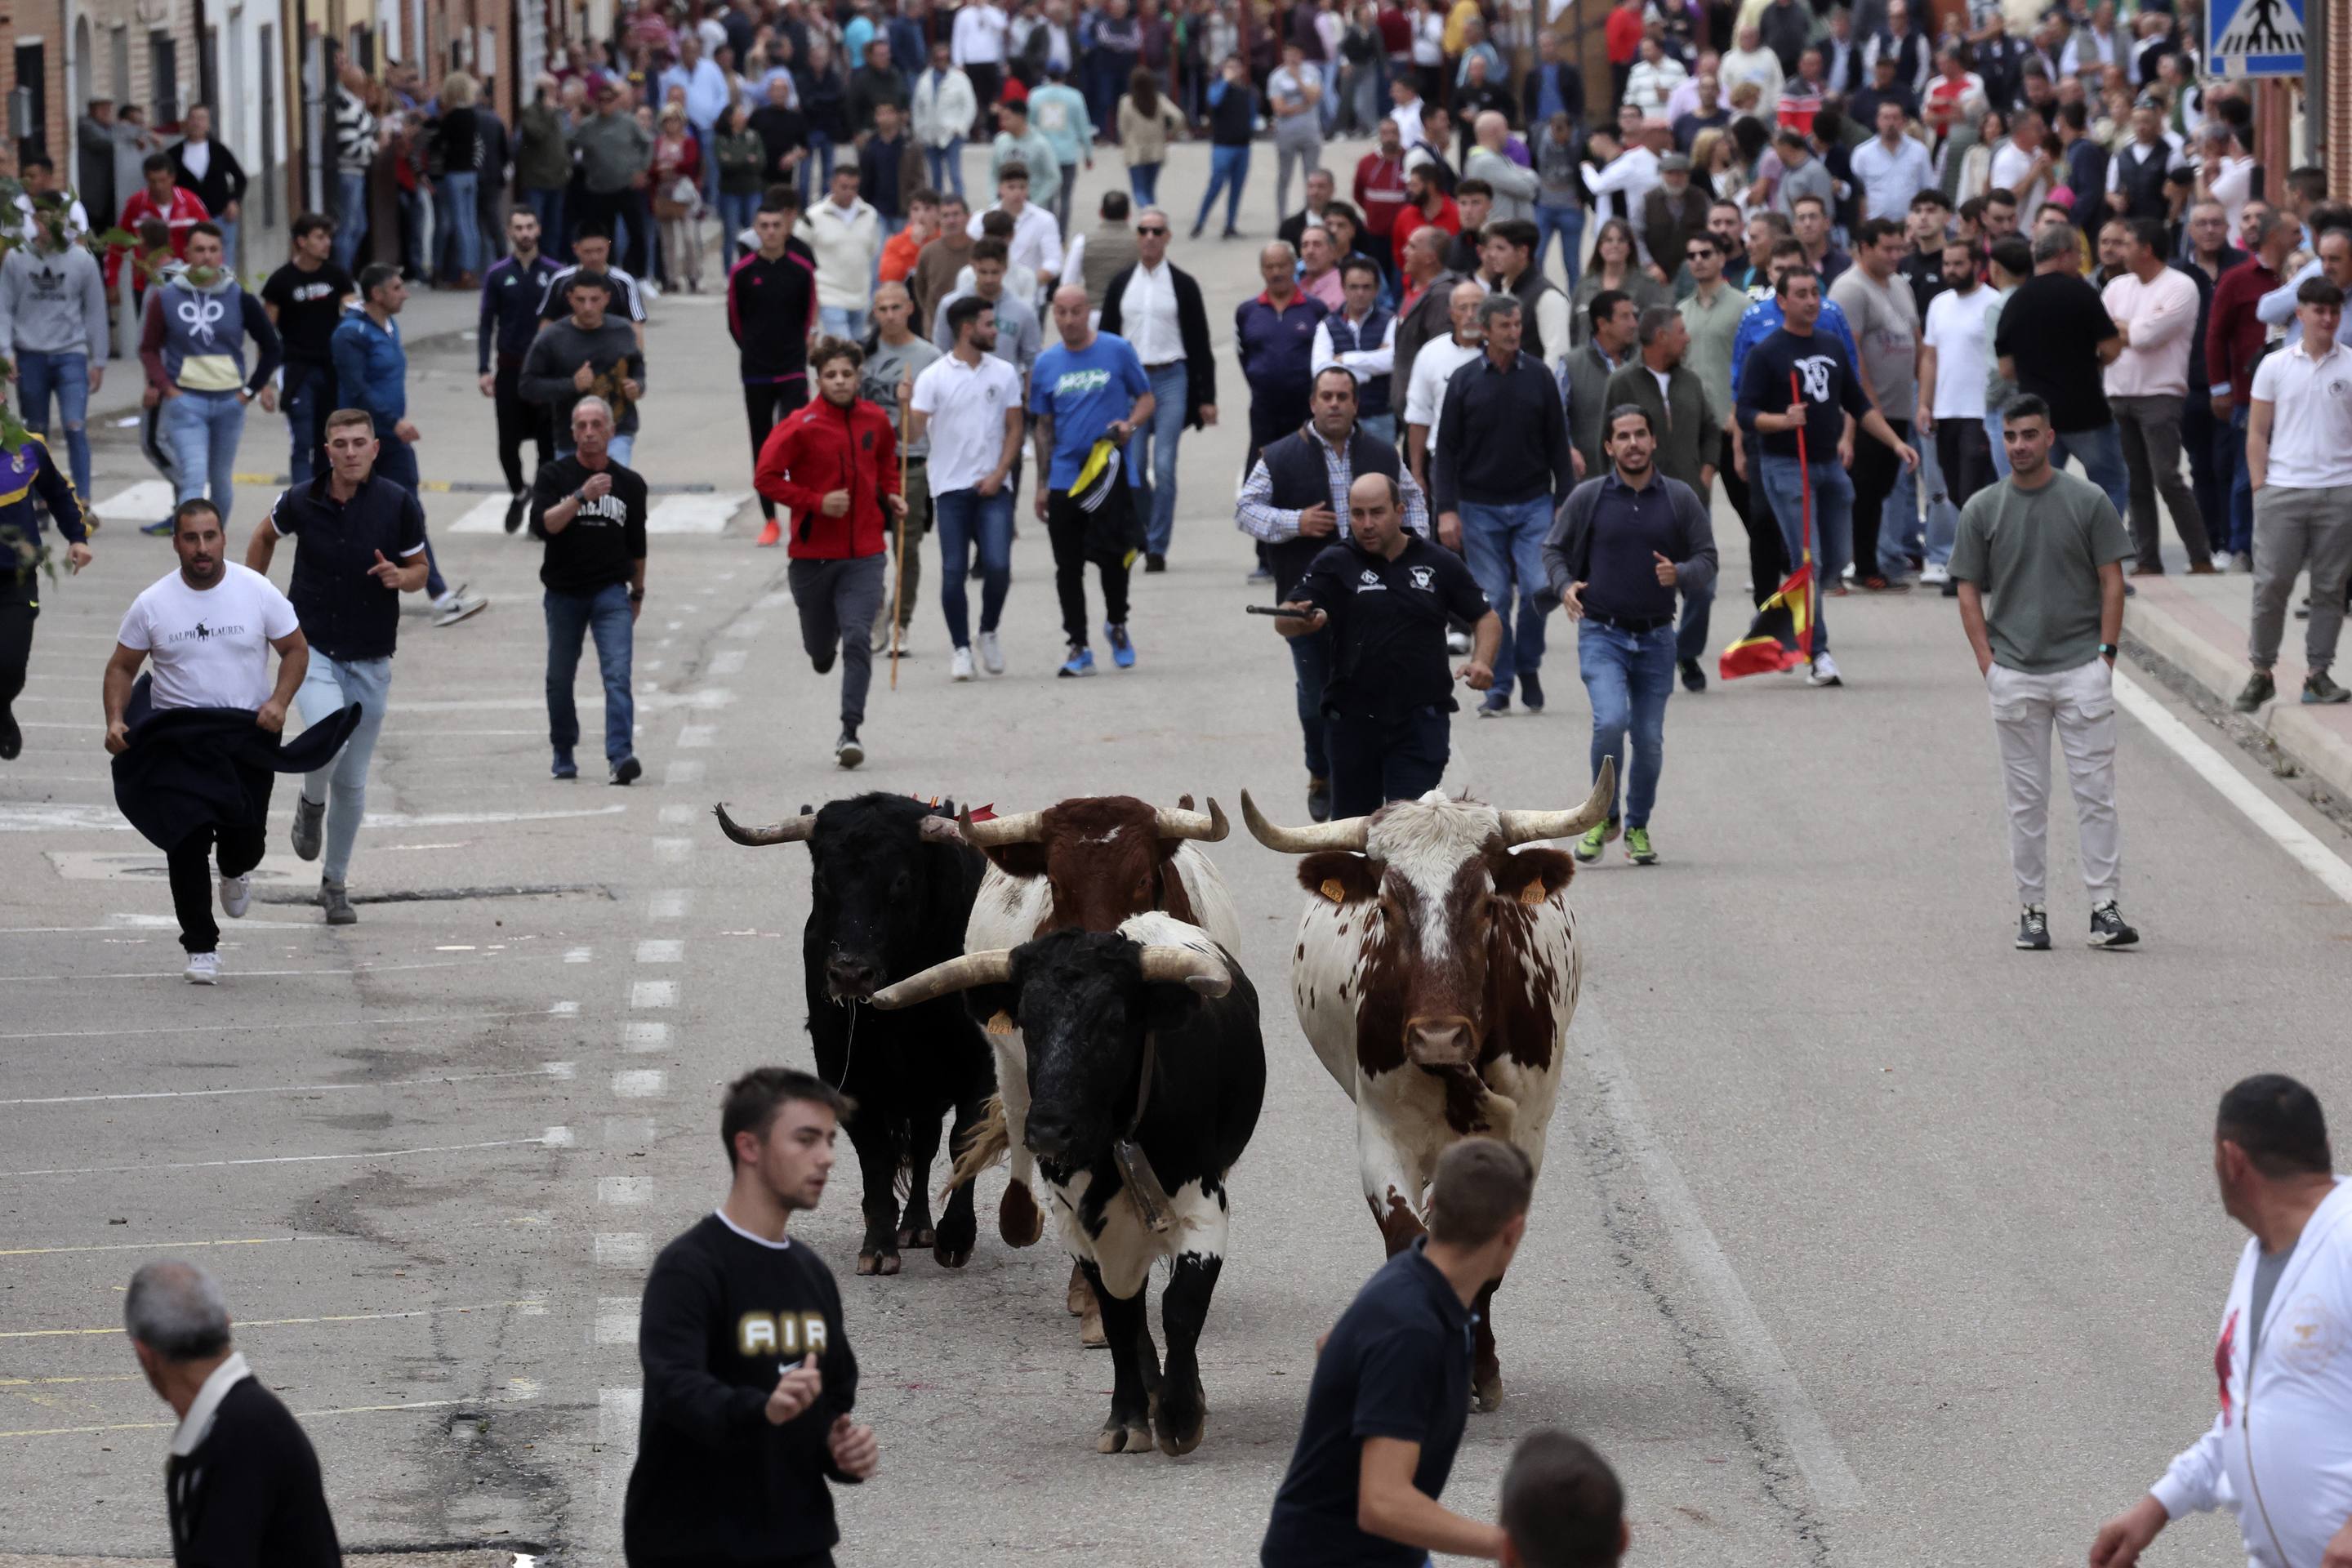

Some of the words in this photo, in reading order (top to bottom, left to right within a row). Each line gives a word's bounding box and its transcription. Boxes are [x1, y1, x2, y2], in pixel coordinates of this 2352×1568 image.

[168, 630, 196, 644] RALPH
[211, 626, 245, 637] LAUREN
[741, 1313, 827, 1352] AIR
